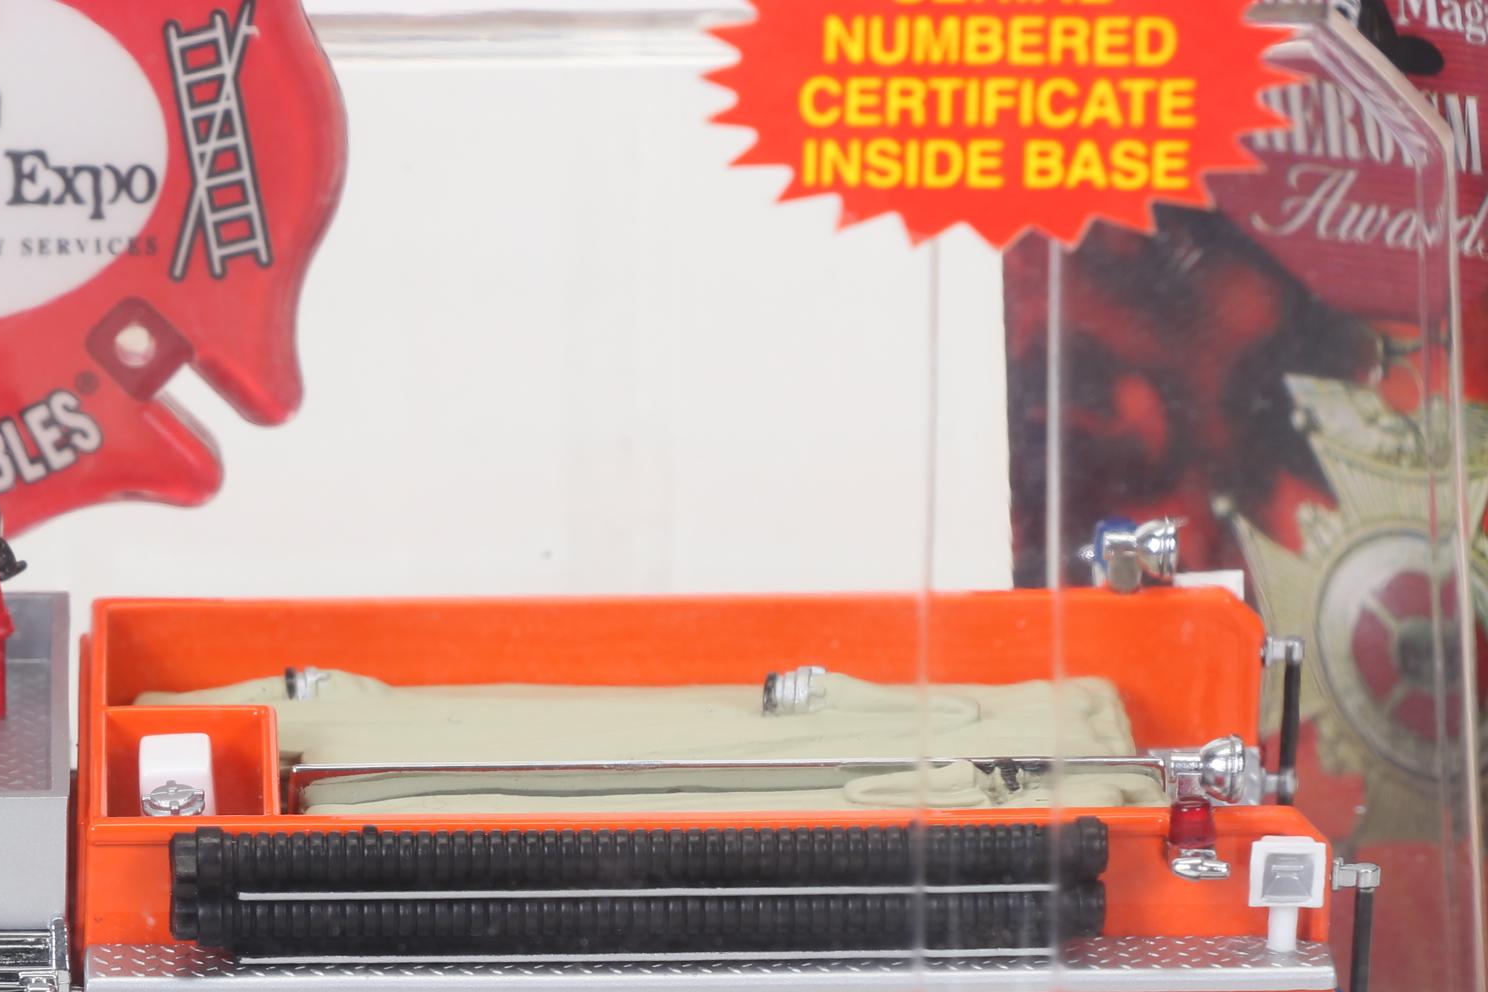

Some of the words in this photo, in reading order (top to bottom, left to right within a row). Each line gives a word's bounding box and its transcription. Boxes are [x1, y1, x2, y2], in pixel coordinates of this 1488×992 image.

[823, 14, 1178, 67] NUMBERED
[799, 75, 1198, 129] CERTIFICATE
[4, 149, 158, 220] Expo
[801, 138, 1004, 189] INSIDE
[1022, 138, 1191, 190] BASE
[20, 235, 160, 257] SERVICES
